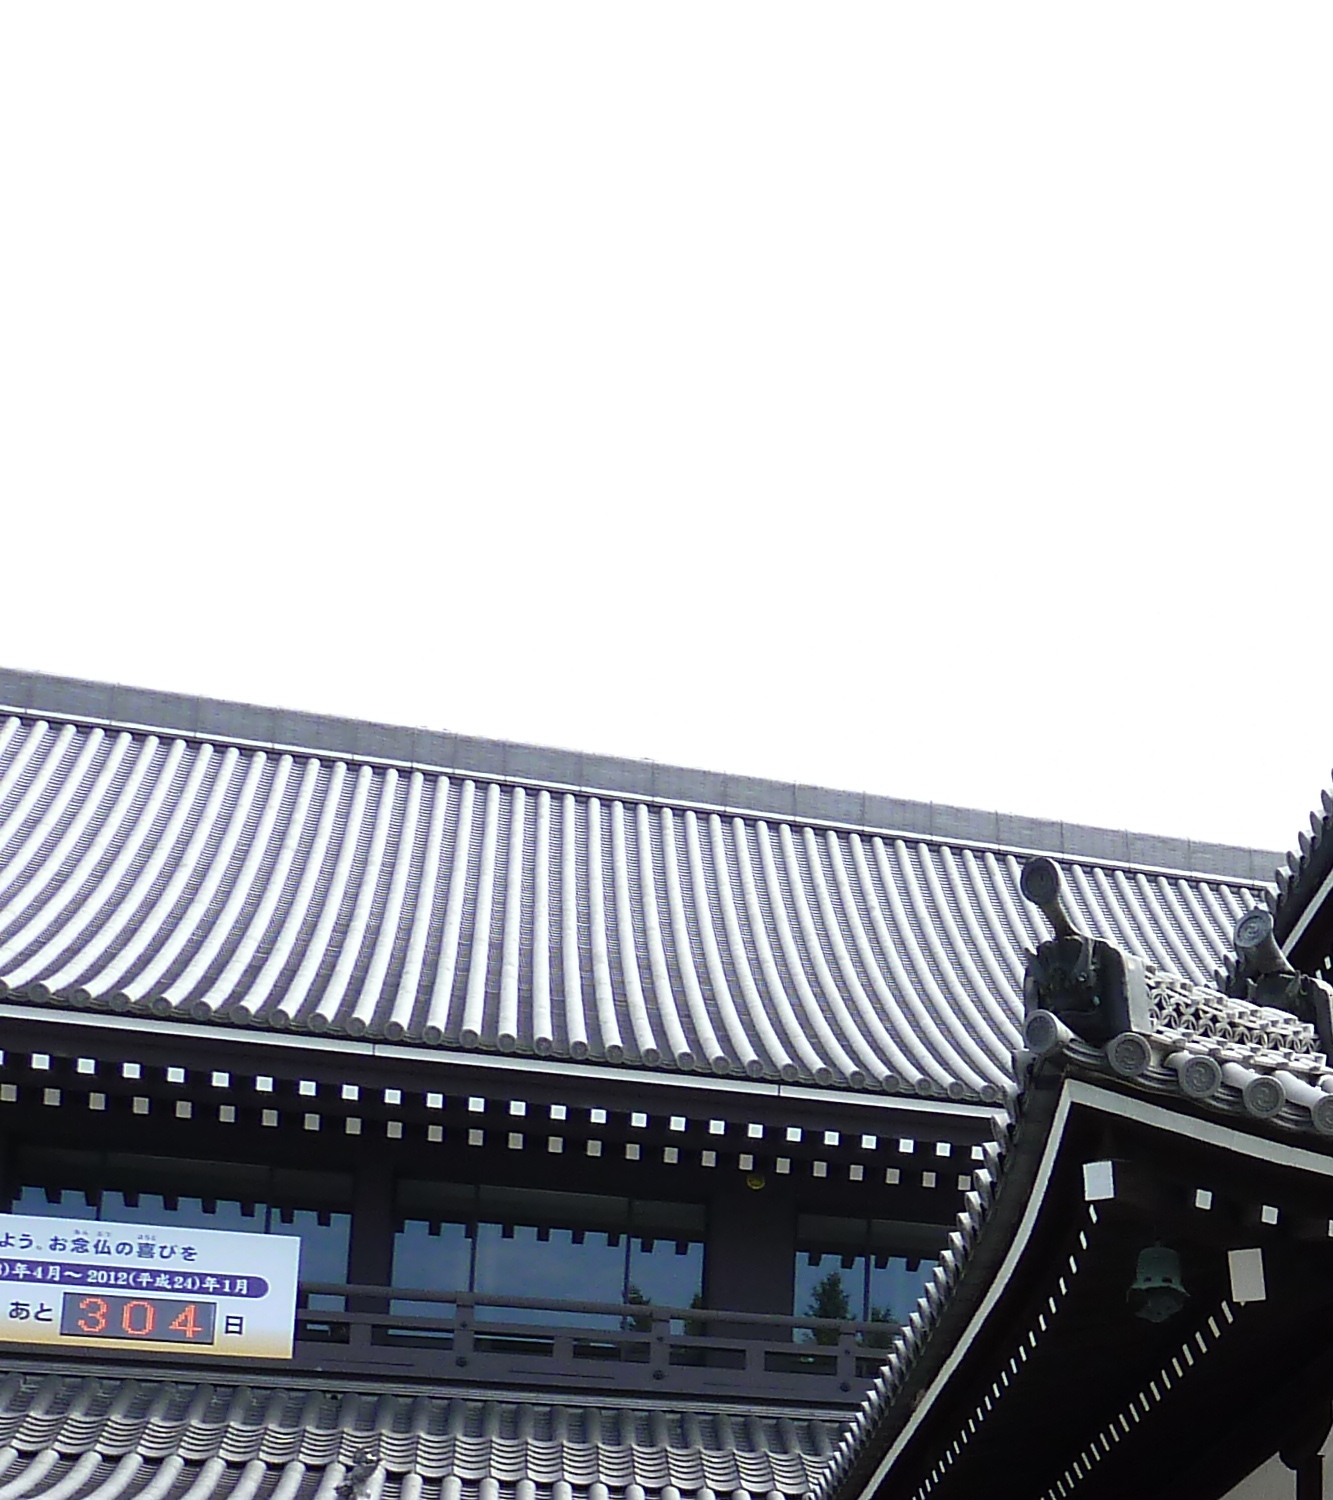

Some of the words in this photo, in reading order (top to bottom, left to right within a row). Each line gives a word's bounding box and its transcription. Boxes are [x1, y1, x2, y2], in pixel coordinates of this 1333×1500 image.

[9, 1301, 53, 1323] あと
[77, 1298, 203, 1339] 304
[225, 1315, 244, 1335] 日
